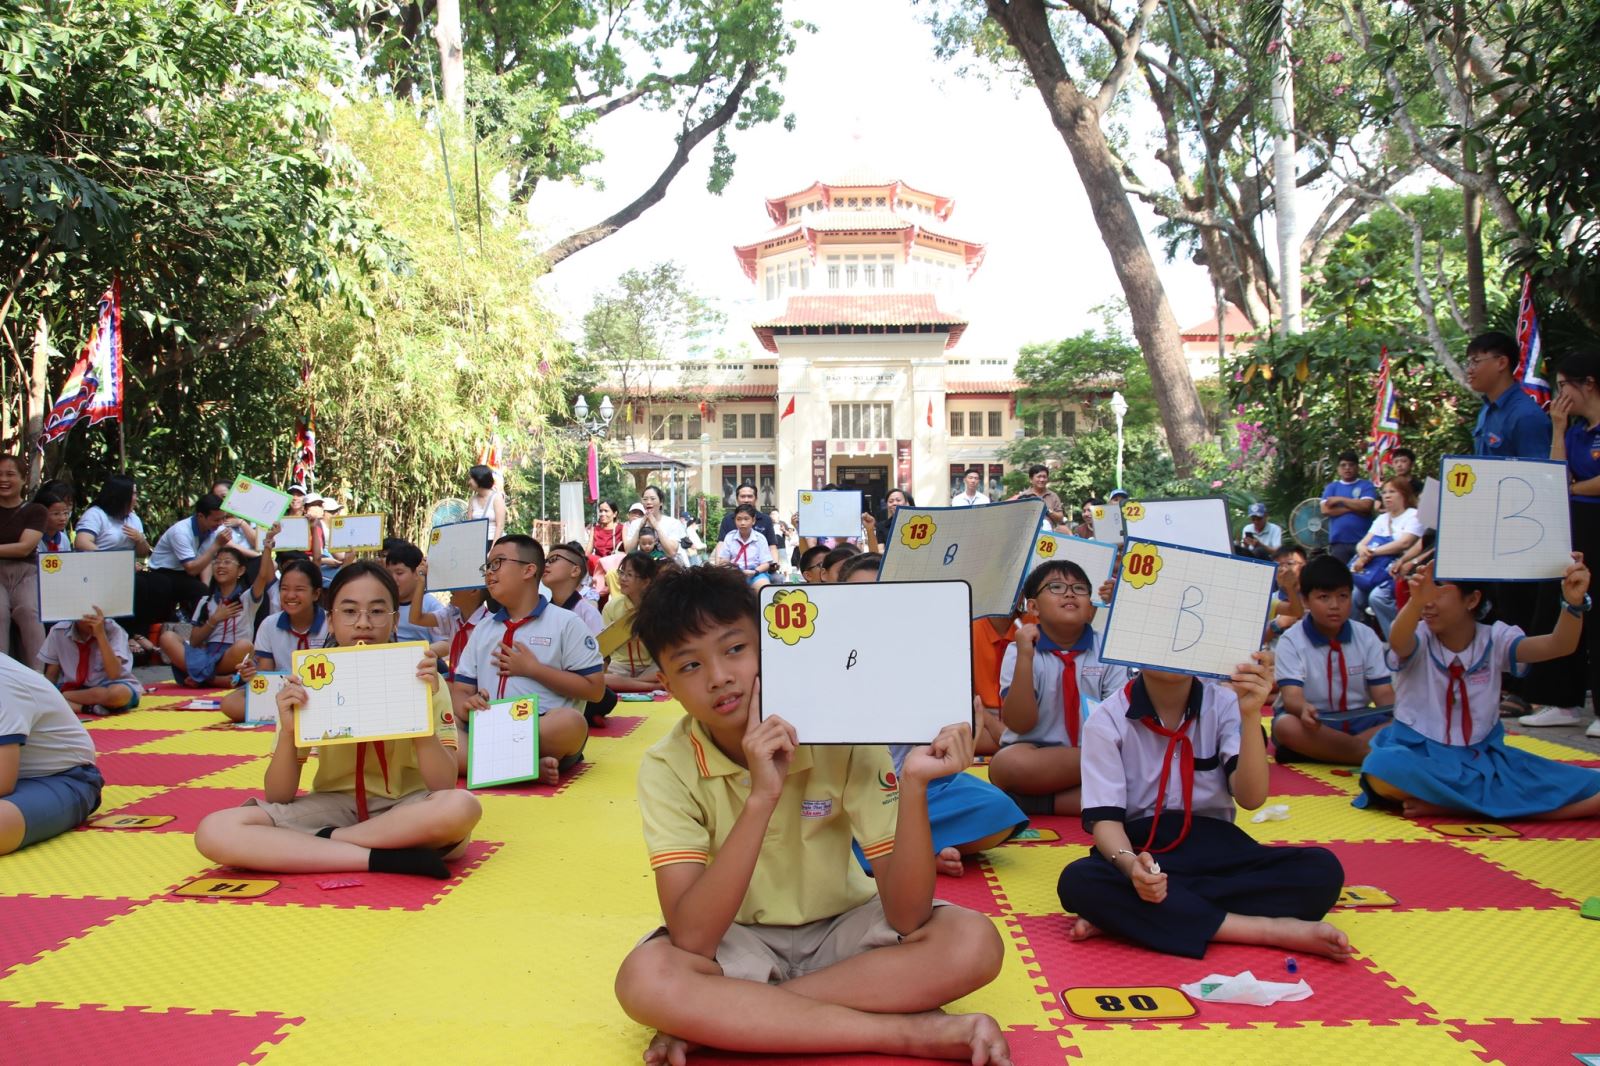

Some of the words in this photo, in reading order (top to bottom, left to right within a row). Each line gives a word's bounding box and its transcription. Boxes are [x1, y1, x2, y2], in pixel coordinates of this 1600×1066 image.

[1454, 472, 1468, 488] 17
[1126, 506, 1141, 517] 22
[1493, 476, 1545, 561] B
[910, 523, 928, 540] 13
[1040, 540, 1054, 553] 28
[45, 559, 58, 569] 36
[1128, 553, 1155, 577] 08
[775, 602, 807, 629] 03
[1172, 585, 1205, 652] B
[846, 649, 858, 670] B
[307, 662, 327, 680] 14
[253, 679, 265, 689] 35
[516, 702, 529, 717] 24
[207, 882, 249, 892] 14
[1094, 994, 1159, 1012] 08
